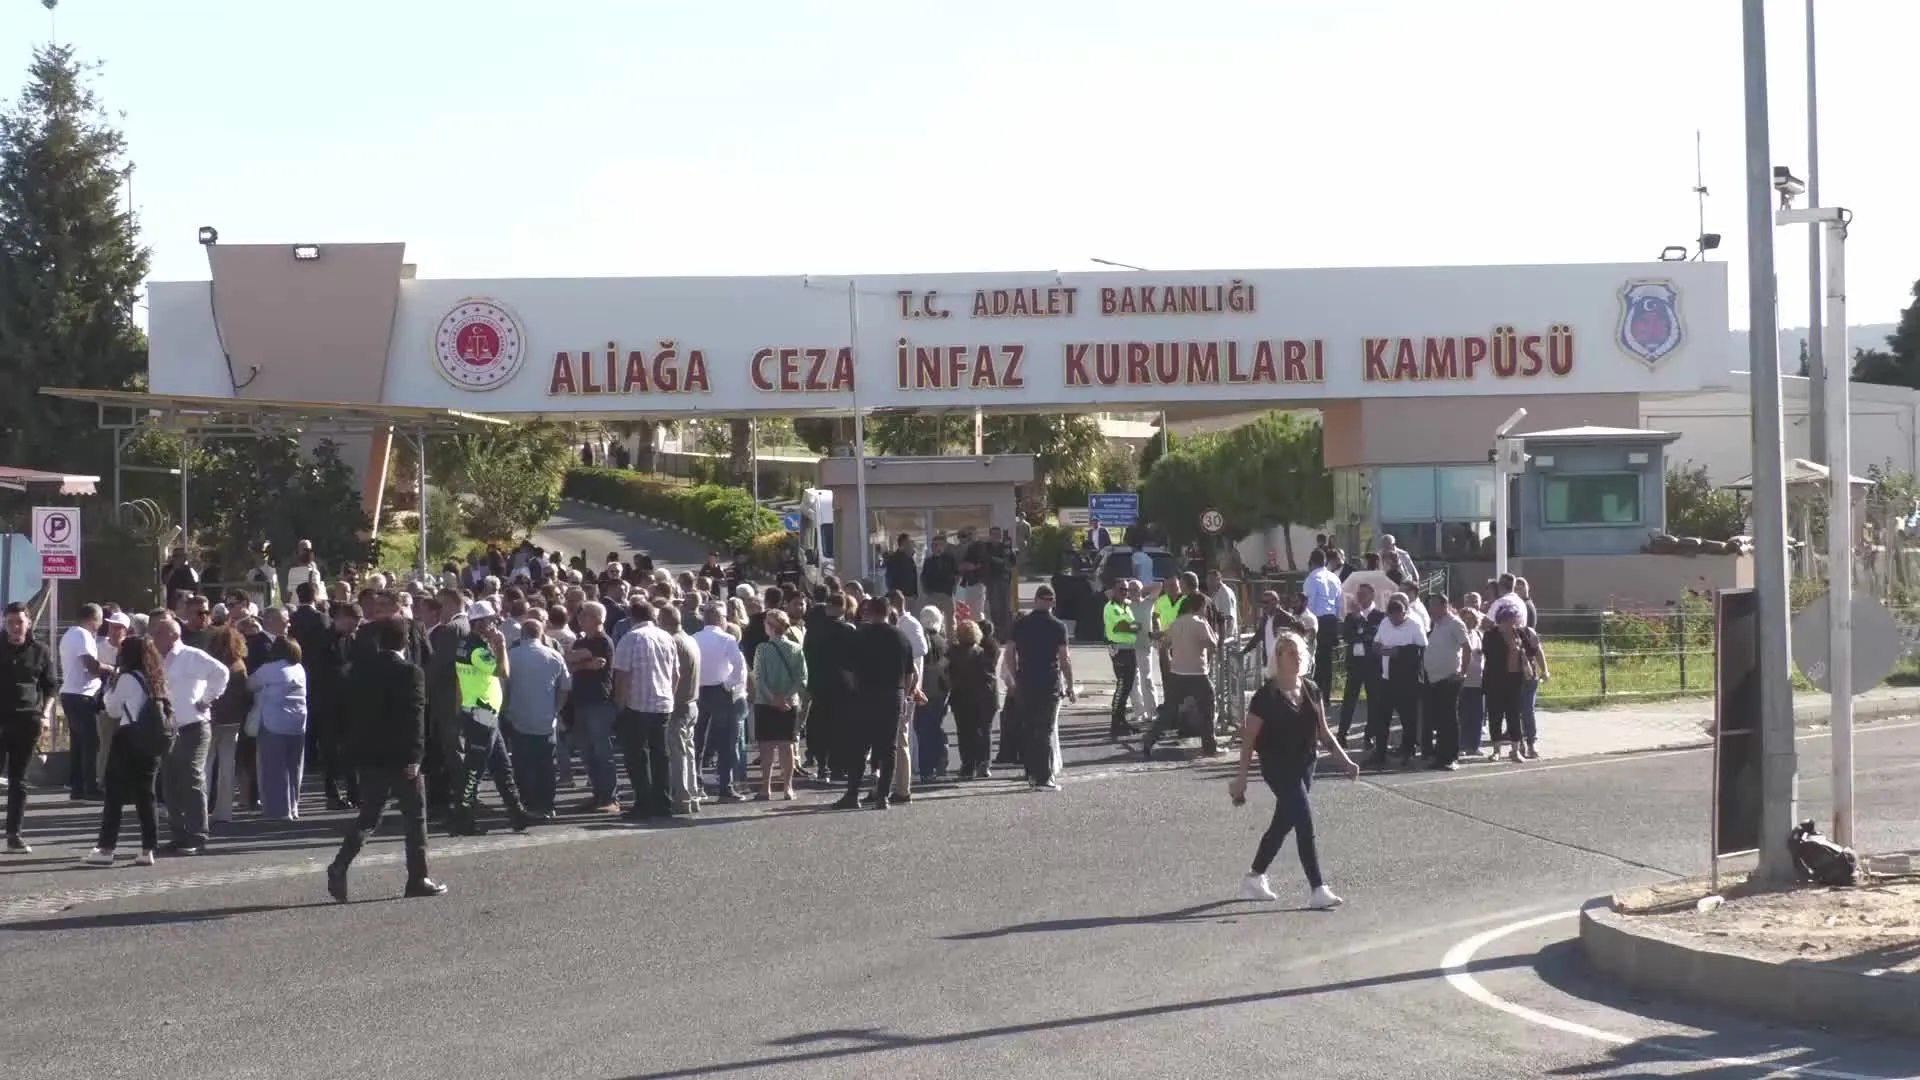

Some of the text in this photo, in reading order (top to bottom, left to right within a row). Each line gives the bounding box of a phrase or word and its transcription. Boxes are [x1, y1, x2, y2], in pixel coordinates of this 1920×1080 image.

[897, 279, 1255, 318] T.C. ADALET BAKANLIĞI
[549, 340, 711, 394] ALİAĞA
[750, 346, 855, 392] CEZA
[897, 336, 1026, 389] İNFAZ
[1063, 340, 1325, 387] KURUMLARI
[1362, 324, 1574, 382] KAMPÜSÜ
